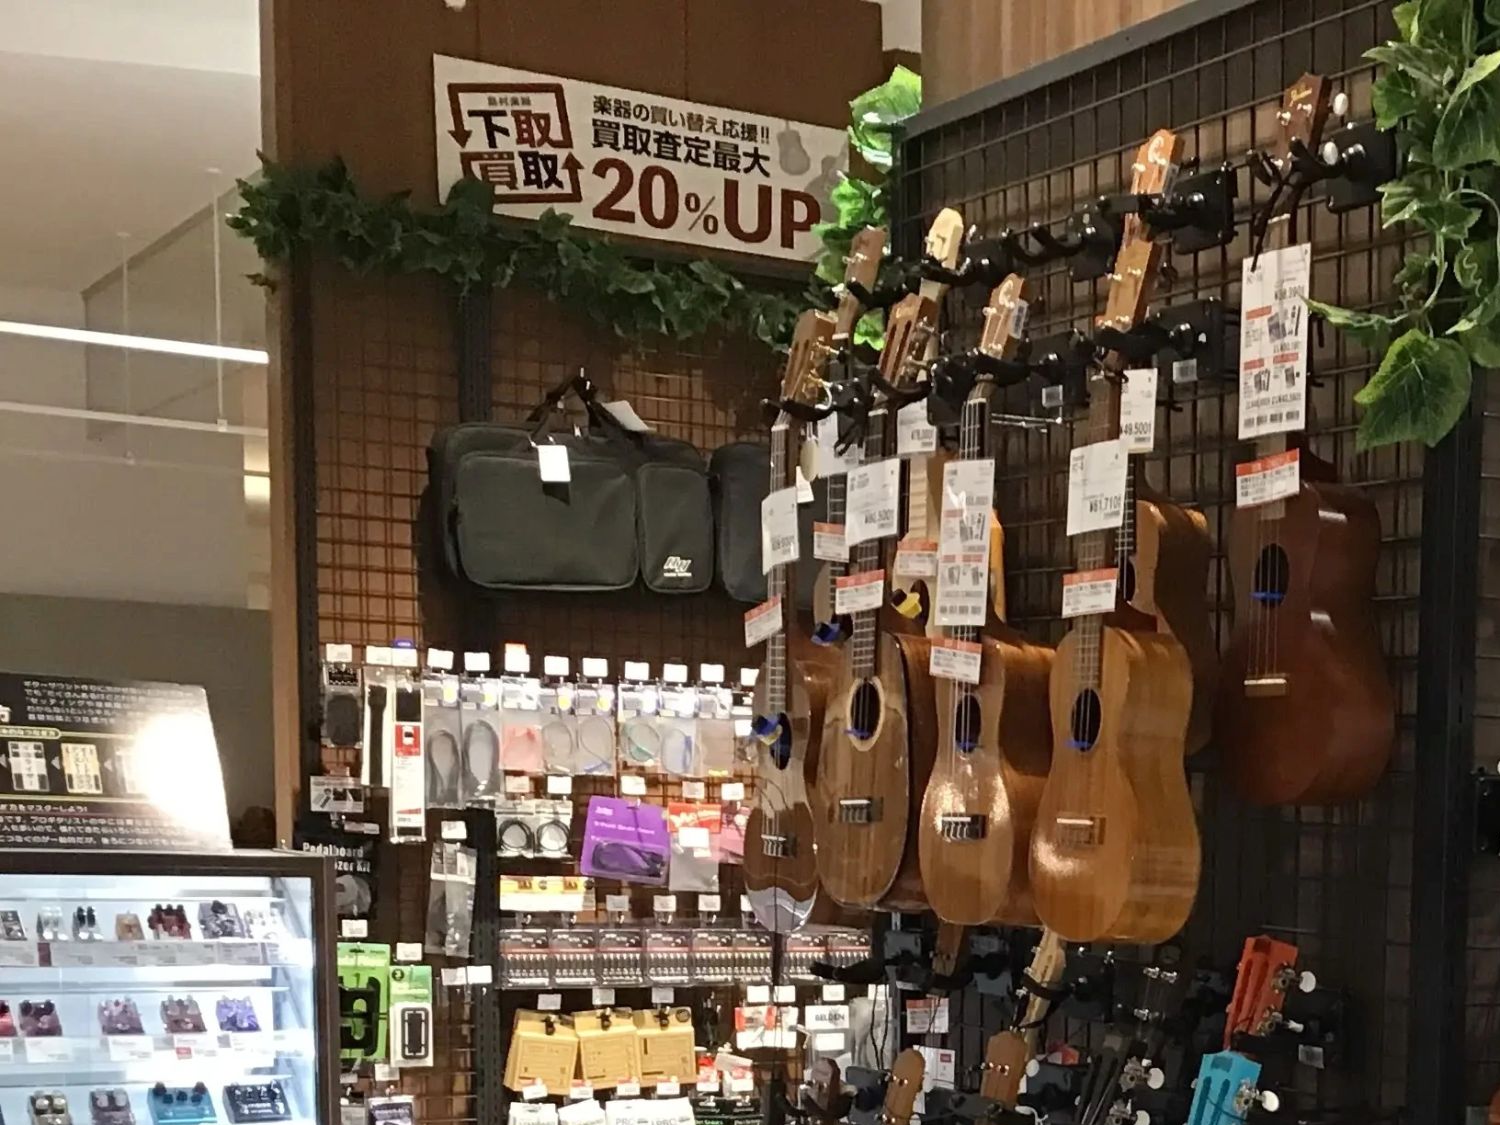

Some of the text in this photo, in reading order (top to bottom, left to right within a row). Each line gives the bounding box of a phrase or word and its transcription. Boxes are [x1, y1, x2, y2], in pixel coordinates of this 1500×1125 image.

[467, 108, 552, 149] 下取
[591, 118, 770, 178] 買取査定最大
[461, 150, 563, 191] 買取
[303, 842, 364, 858] Pedalboard
[815, 1013, 846, 1024] BELDEN
